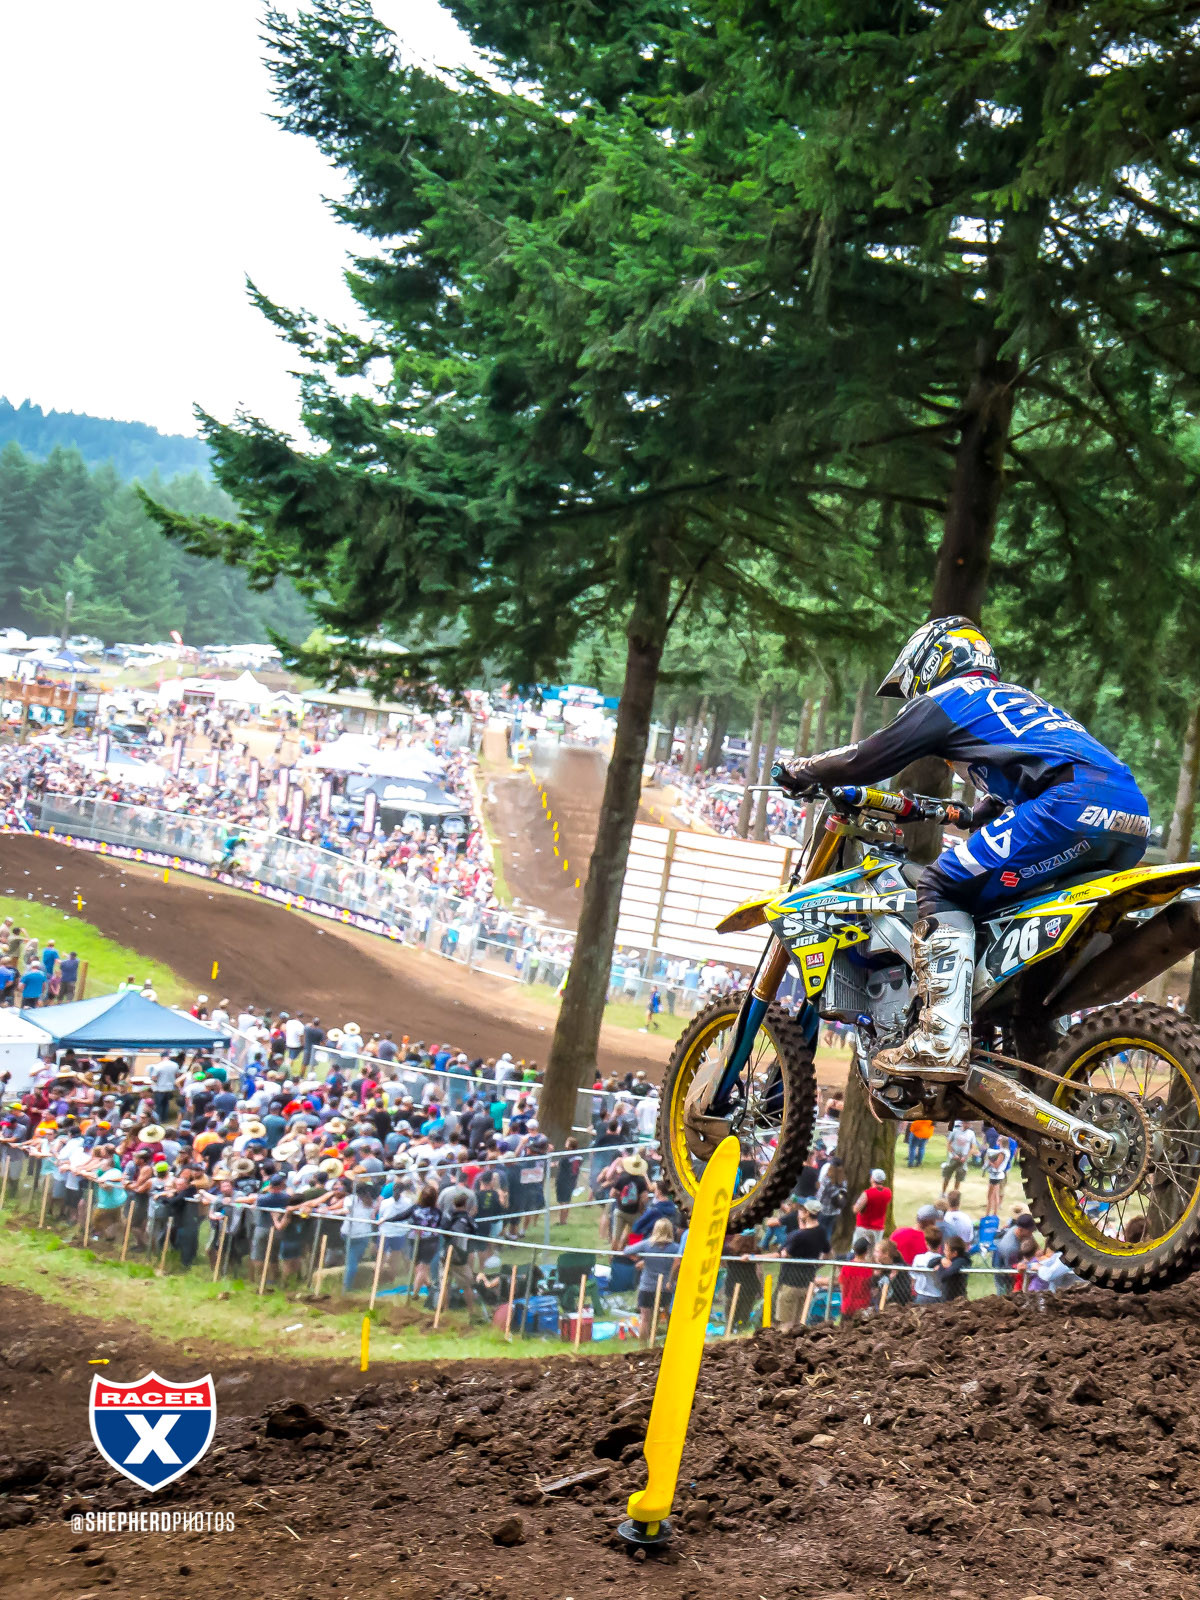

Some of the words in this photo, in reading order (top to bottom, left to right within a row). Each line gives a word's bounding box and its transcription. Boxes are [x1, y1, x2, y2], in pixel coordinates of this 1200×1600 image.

[922, 655, 941, 678] Arai
[973, 651, 997, 670] ALEX
[1019, 840, 1092, 879] SUZUKI
[782, 893, 906, 937] SUZUKI
[791, 934, 819, 949] JGR
[1000, 916, 1041, 975] 26
[936, 956, 955, 974] G
